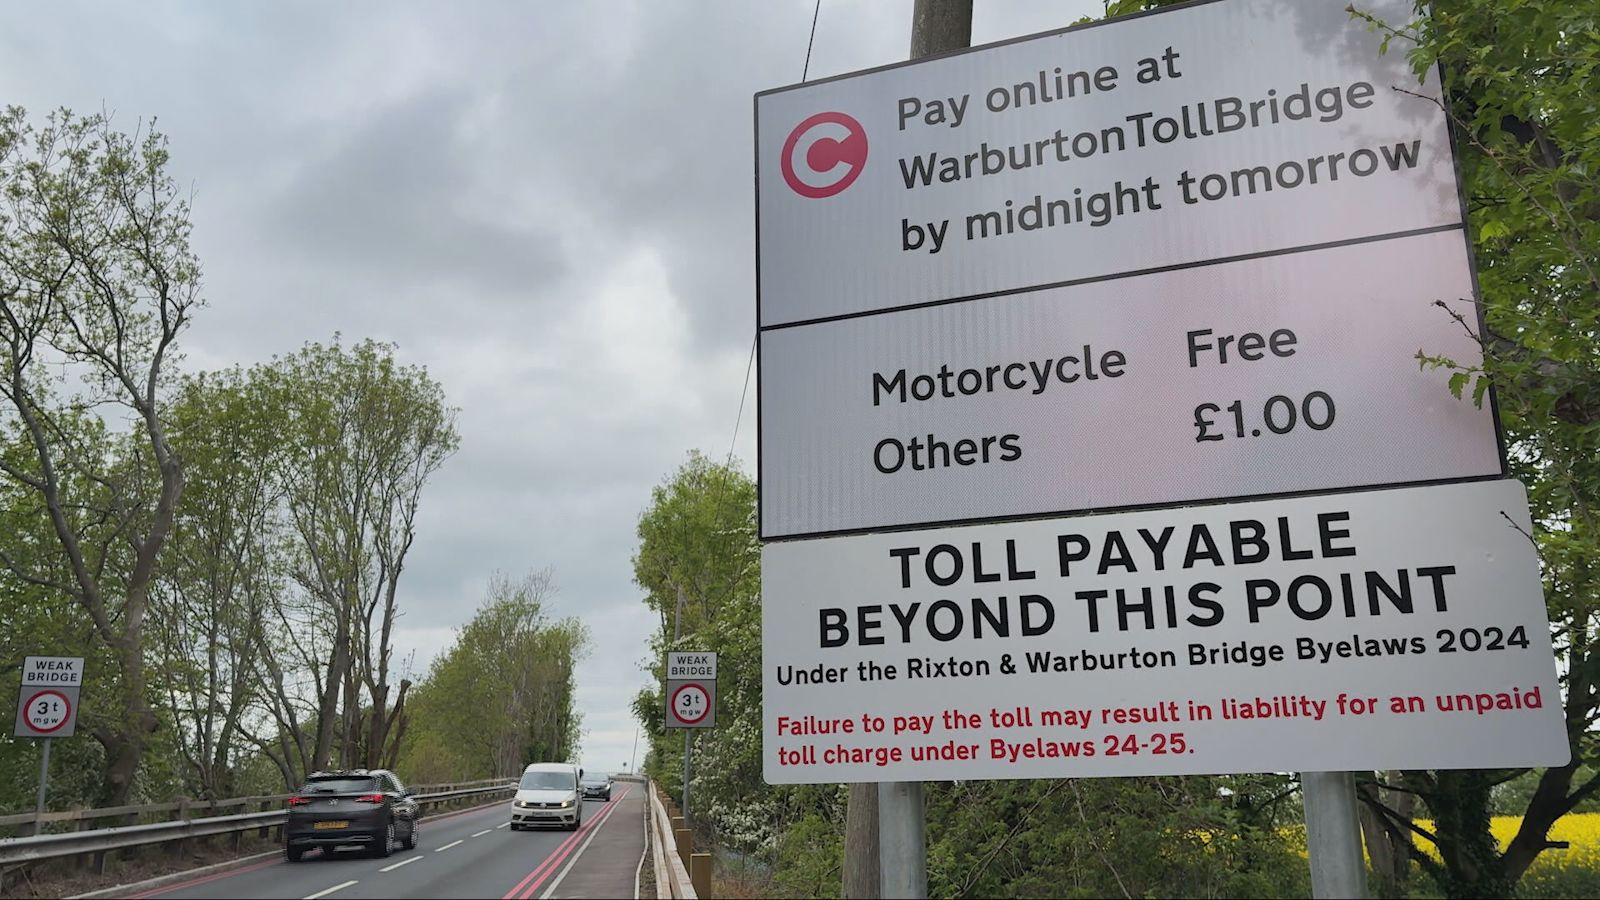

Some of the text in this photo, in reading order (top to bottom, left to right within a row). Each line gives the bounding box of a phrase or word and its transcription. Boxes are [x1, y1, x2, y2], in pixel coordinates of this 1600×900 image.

[898, 45, 1182, 132] Pay online at
[898, 81, 1375, 190] WarburtonTollBridge
[901, 139, 1422, 255] by midnight tomorrow
[872, 327, 1298, 407] Motorcycle Free
[873, 390, 1336, 475] Others £1.00
[889, 510, 1357, 589] TOLL PAYABLE
[819, 564, 1457, 649] BEYOND THIS POINT
[27, 672, 78, 682] BRIDGE
[36, 661, 74, 671] WEAK
[671, 666, 713, 675] BRIDGE
[677, 656, 708, 665] WEAK
[776, 625, 1531, 688] Under the Rixton & Warburton Bridge Byelaws 2024
[777, 685, 1543, 737] Failure to pay the toll may result in liability for an unpaid
[777, 732, 1195, 768] toll charge under Byelaws 24-25.
